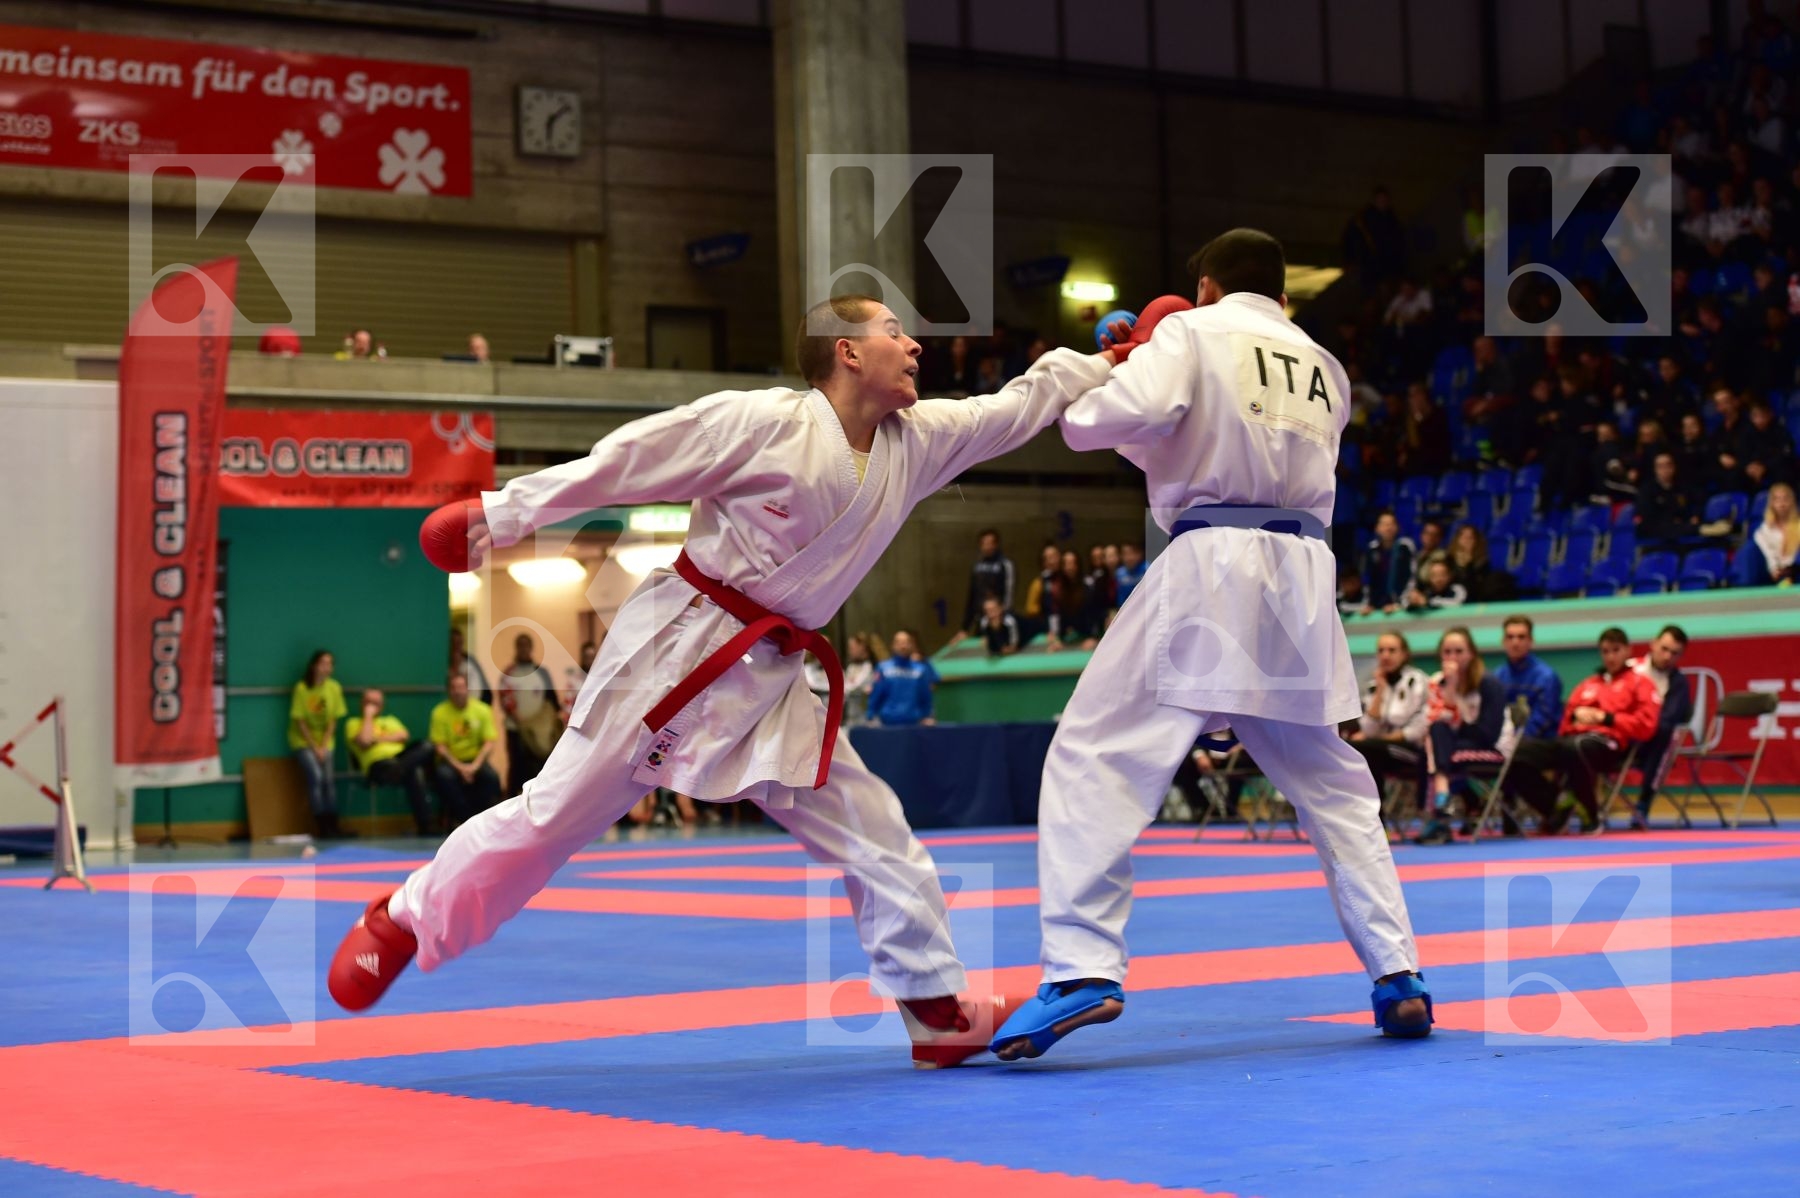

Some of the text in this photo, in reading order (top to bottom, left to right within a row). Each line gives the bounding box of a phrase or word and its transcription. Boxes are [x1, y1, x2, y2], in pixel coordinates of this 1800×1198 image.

[0, 46, 460, 114] meinsam für den Sport.
[78, 119, 141, 146] ZKS
[1254, 346, 1332, 414] ITA
[153, 411, 188, 557] CLEAN
[220, 438, 411, 477] OL & CLEAN
[152, 564, 186, 600] &
[151, 607, 186, 725] COOL
